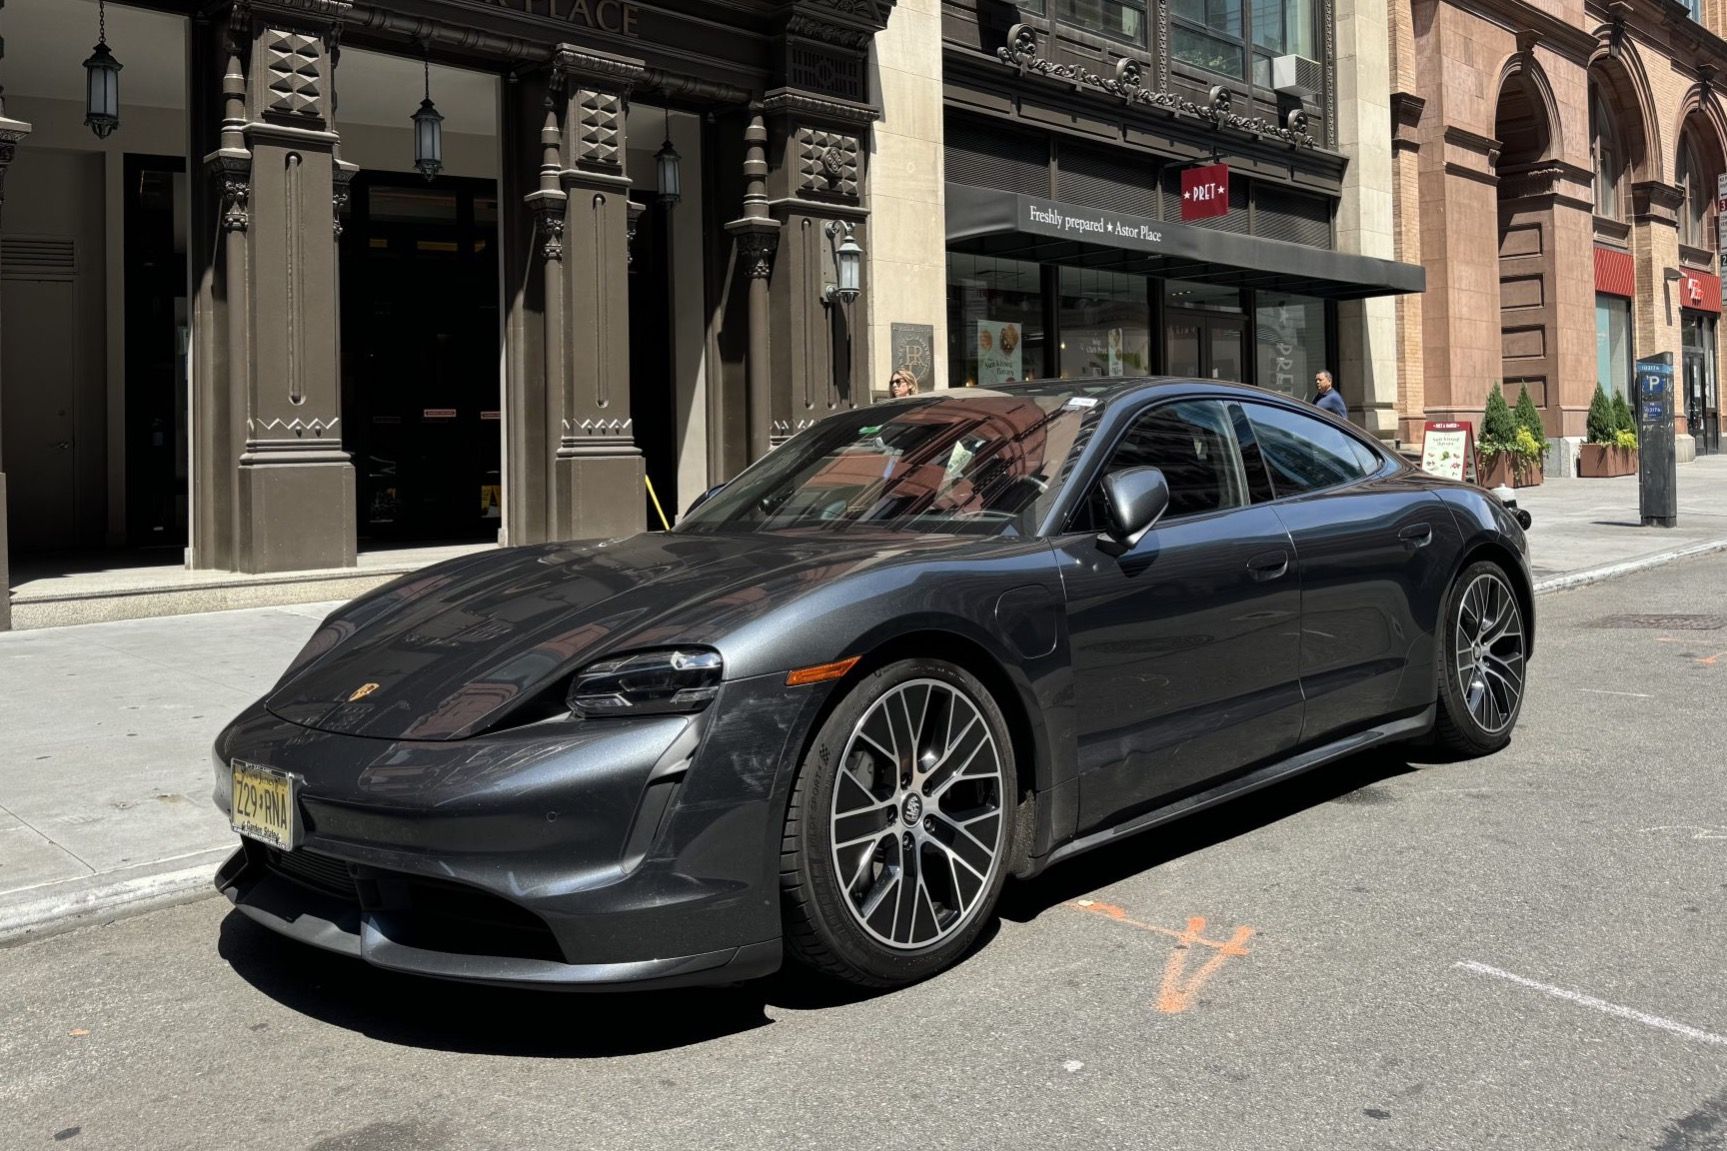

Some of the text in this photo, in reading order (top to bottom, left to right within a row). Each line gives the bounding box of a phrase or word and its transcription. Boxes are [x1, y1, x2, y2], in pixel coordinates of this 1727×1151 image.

[1193, 183, 1216, 202] PRET
[1029, 205, 1162, 242] Freshly prepared Astor Place
